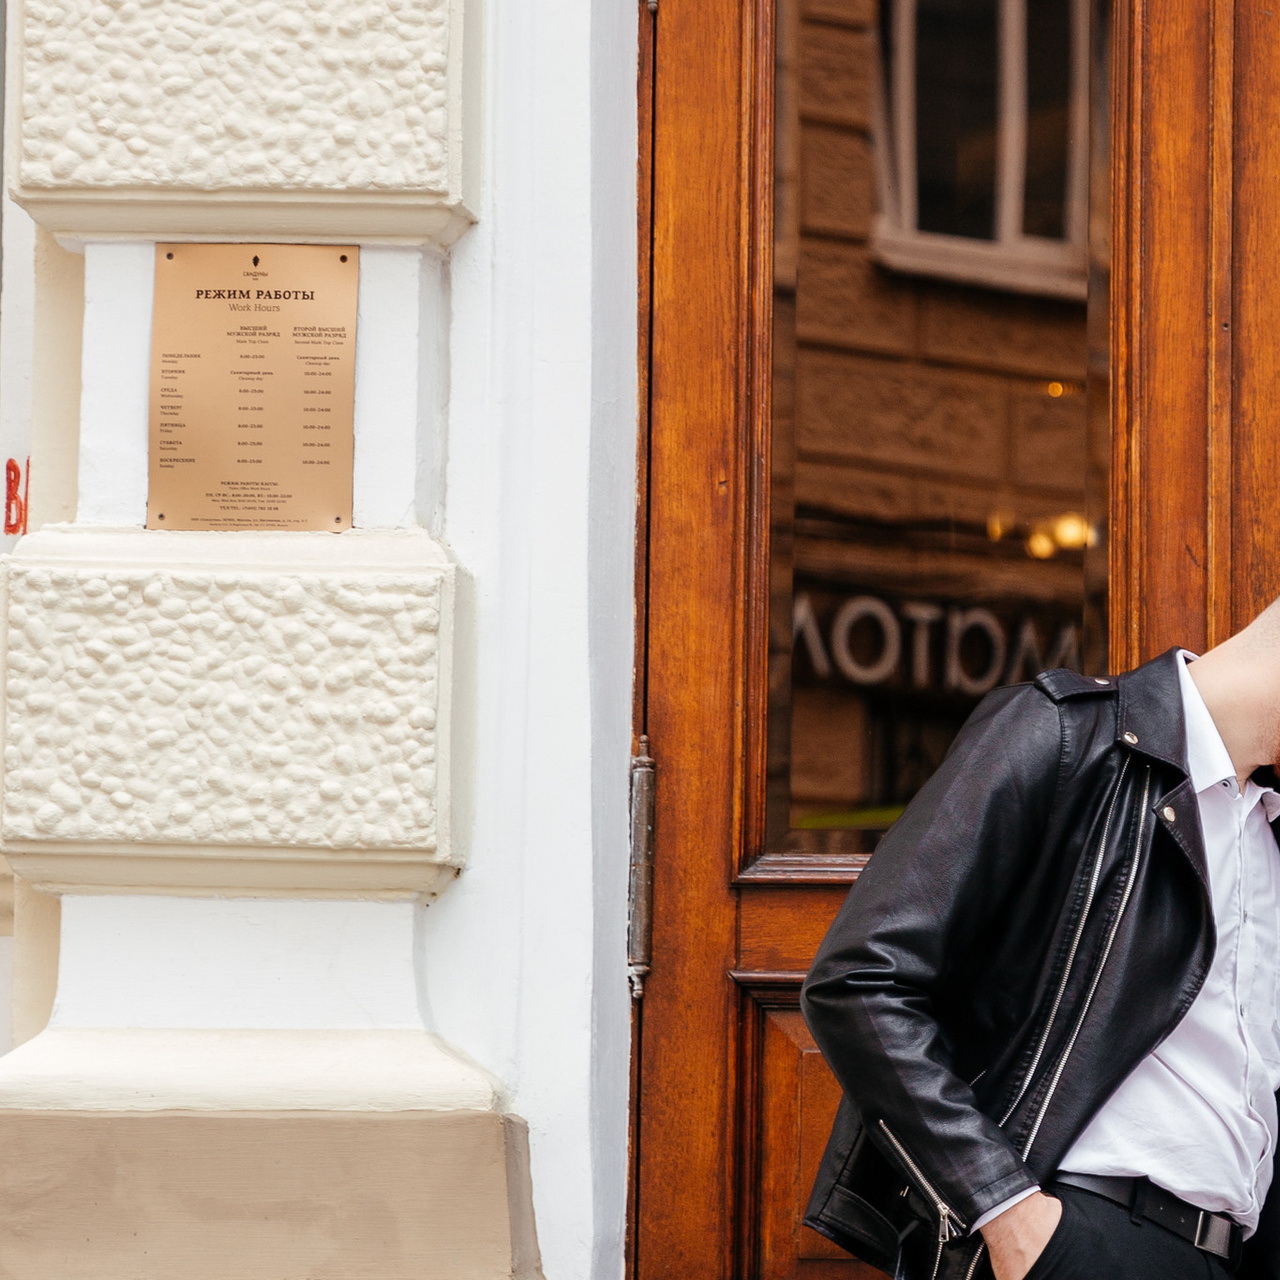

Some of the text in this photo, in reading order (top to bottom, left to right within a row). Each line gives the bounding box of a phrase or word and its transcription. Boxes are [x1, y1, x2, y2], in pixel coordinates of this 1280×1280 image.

[196, 289, 315, 300] РЕЖИМ РАБОТЫ
[228, 303, 280, 312] Work Hours
